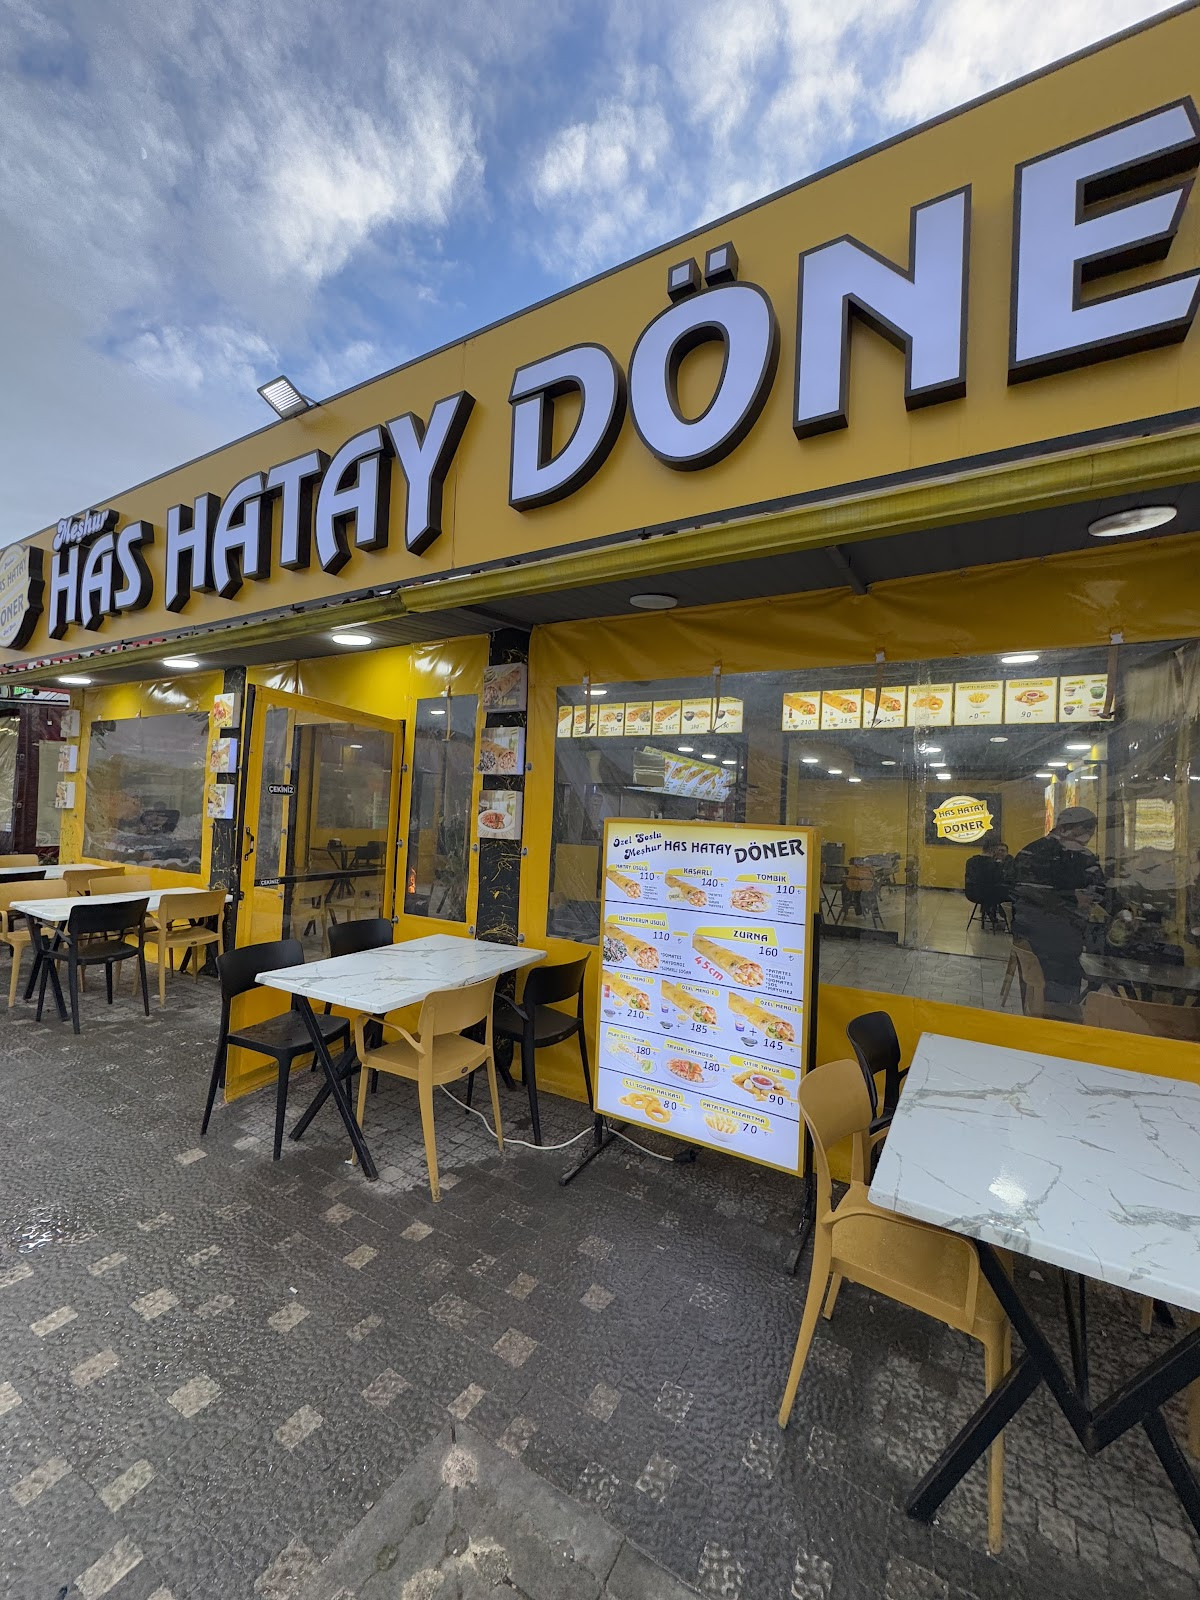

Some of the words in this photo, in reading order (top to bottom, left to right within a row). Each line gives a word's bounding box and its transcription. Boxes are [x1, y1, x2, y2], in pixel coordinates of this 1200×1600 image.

[48, 520, 150, 639] HAS
[165, 390, 475, 613] HATAY
[269, 785, 294, 794] ÇEKİNİZ
[938, 809, 956, 818] HAS
[957, 803, 985, 815] HATAY
[635, 831, 662, 843] Soslu
[664, 840, 687, 852] HAS
[691, 842, 732, 856] HATAY
[734, 838, 805, 864] DÖNER
[640, 872, 655, 881] 110
[701, 878, 718, 888] 140
[776, 885, 795, 895] 110
[652, 931, 670, 941] 110
[733, 930, 768, 942] ZURNA
[758, 946, 778, 957] 160
[627, 1008, 645, 1019] 210
[690, 1022, 708, 1034] 185
[635, 1045, 651, 1056] 180
[762, 1038, 783, 1051] 145
[702, 1060, 720, 1072] 180
[663, 1100, 677, 1111] 80
[769, 1094, 784, 1106] 90
[702, 1101, 730, 1114] PATATES
[731, 1109, 765, 1124] KIZARTMA
[742, 1122, 758, 1135] 70
